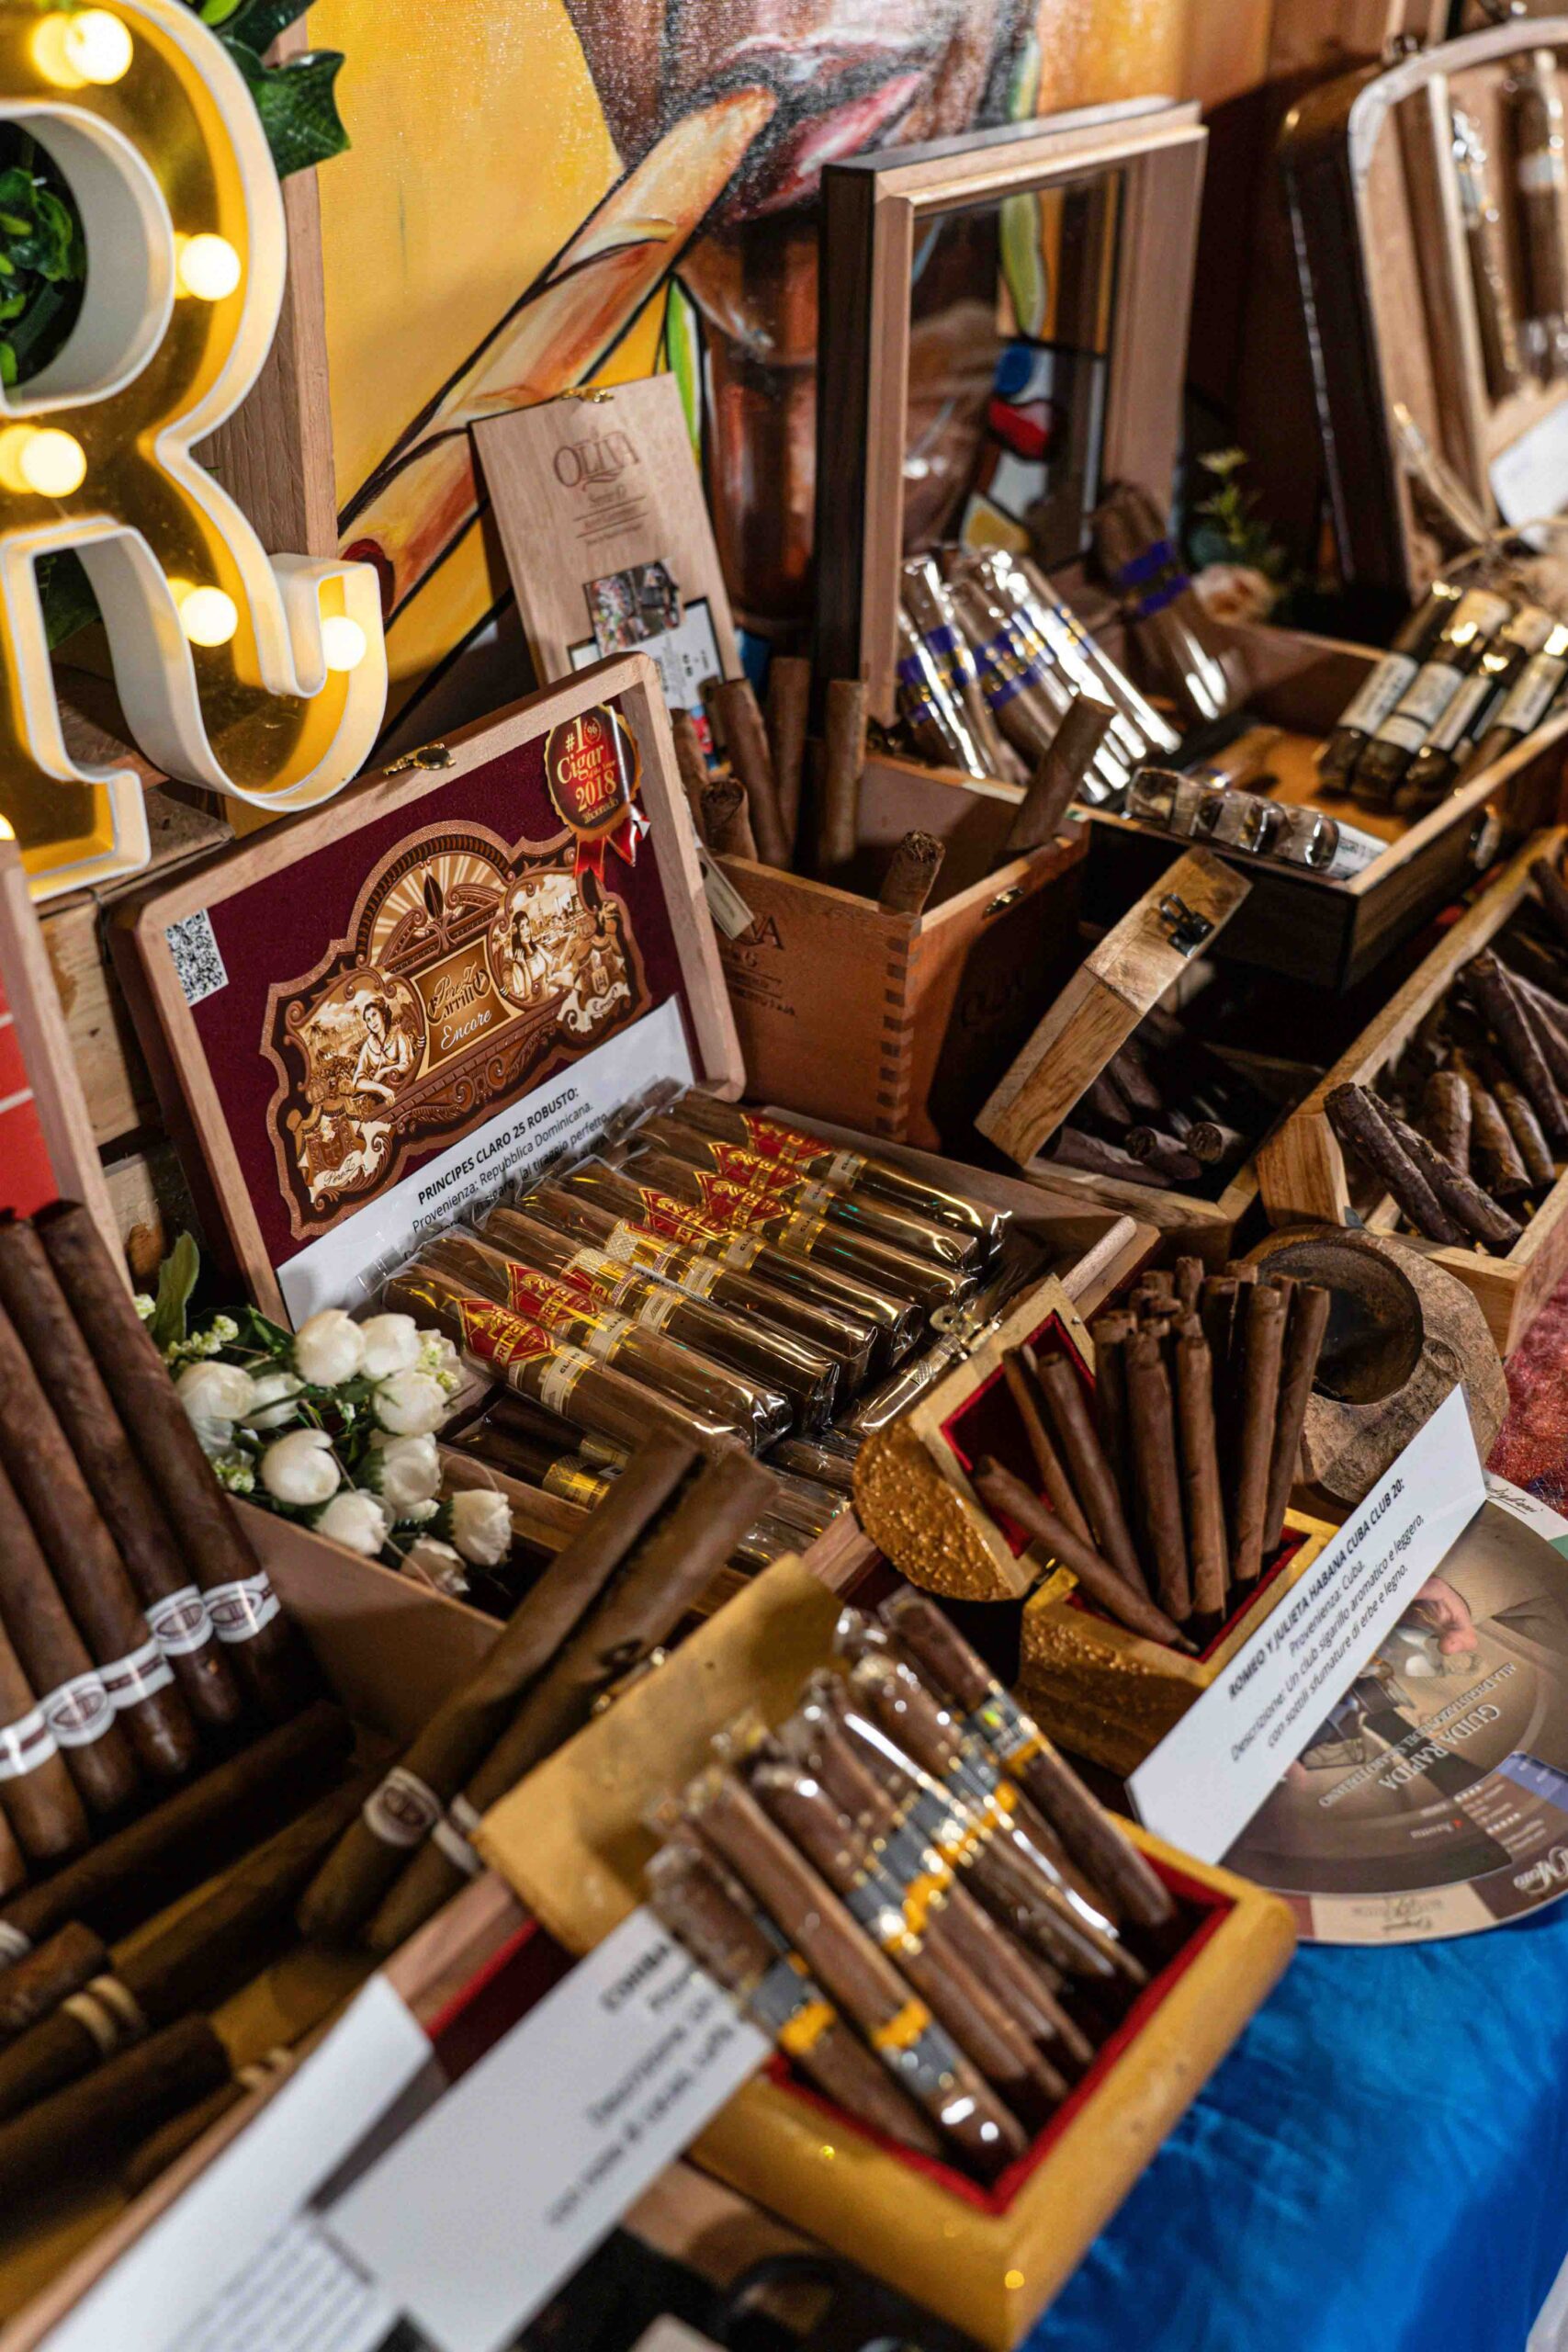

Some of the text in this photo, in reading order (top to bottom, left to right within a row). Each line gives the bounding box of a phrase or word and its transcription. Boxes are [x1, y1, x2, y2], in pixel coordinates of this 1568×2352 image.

[553, 430, 640, 492] OLIVA
[557, 745, 604, 784] Cigar
[565, 716, 589, 753] #1
[575, 769, 617, 812] 2018
[441, 1009, 492, 1050] Encore
[412, 1181, 479, 1234] Provenienza:
[479, 1143, 534, 1188] Repubblica
[535, 1102, 593, 1146] Dominicana.
[417, 1087, 580, 1204] PRINCIPES CLARO 25 ROBUSTO:
[533, 1141, 569, 1173] tiraggio
[570, 1112, 610, 1148] perfetto,
[1228, 1653, 1266, 1701] ROMEO
[1272, 1599, 1310, 1652] JULIETA
[1309, 1551, 1347, 1605] HABANA
[1346, 1521, 1371, 1556] CUBA
[1370, 1495, 1394, 1528] CLUB
[1392, 1477, 1406, 1499] 20:
[1288, 1559, 1366, 1657] Provenienza: Cuba.
[1231, 1690, 1287, 1763] Descrizione:
[1285, 1672, 1301, 1695] Un
[1299, 1644, 1320, 1677] club
[1318, 1608, 1352, 1654] sigarillo
[1350, 1557, 1390, 1613] aromatico
[1393, 1514, 1425, 1557] leggero,
[1267, 1720, 1287, 1749] con
[1286, 1689, 1310, 1724] sottili
[1309, 1636, 1353, 1695] sfumature
[1359, 1599, 1380, 1628] erbe
[1383, 1565, 1409, 1601] legno.
[1378, 1703, 1501, 1792] GUIDA RAPIDA
